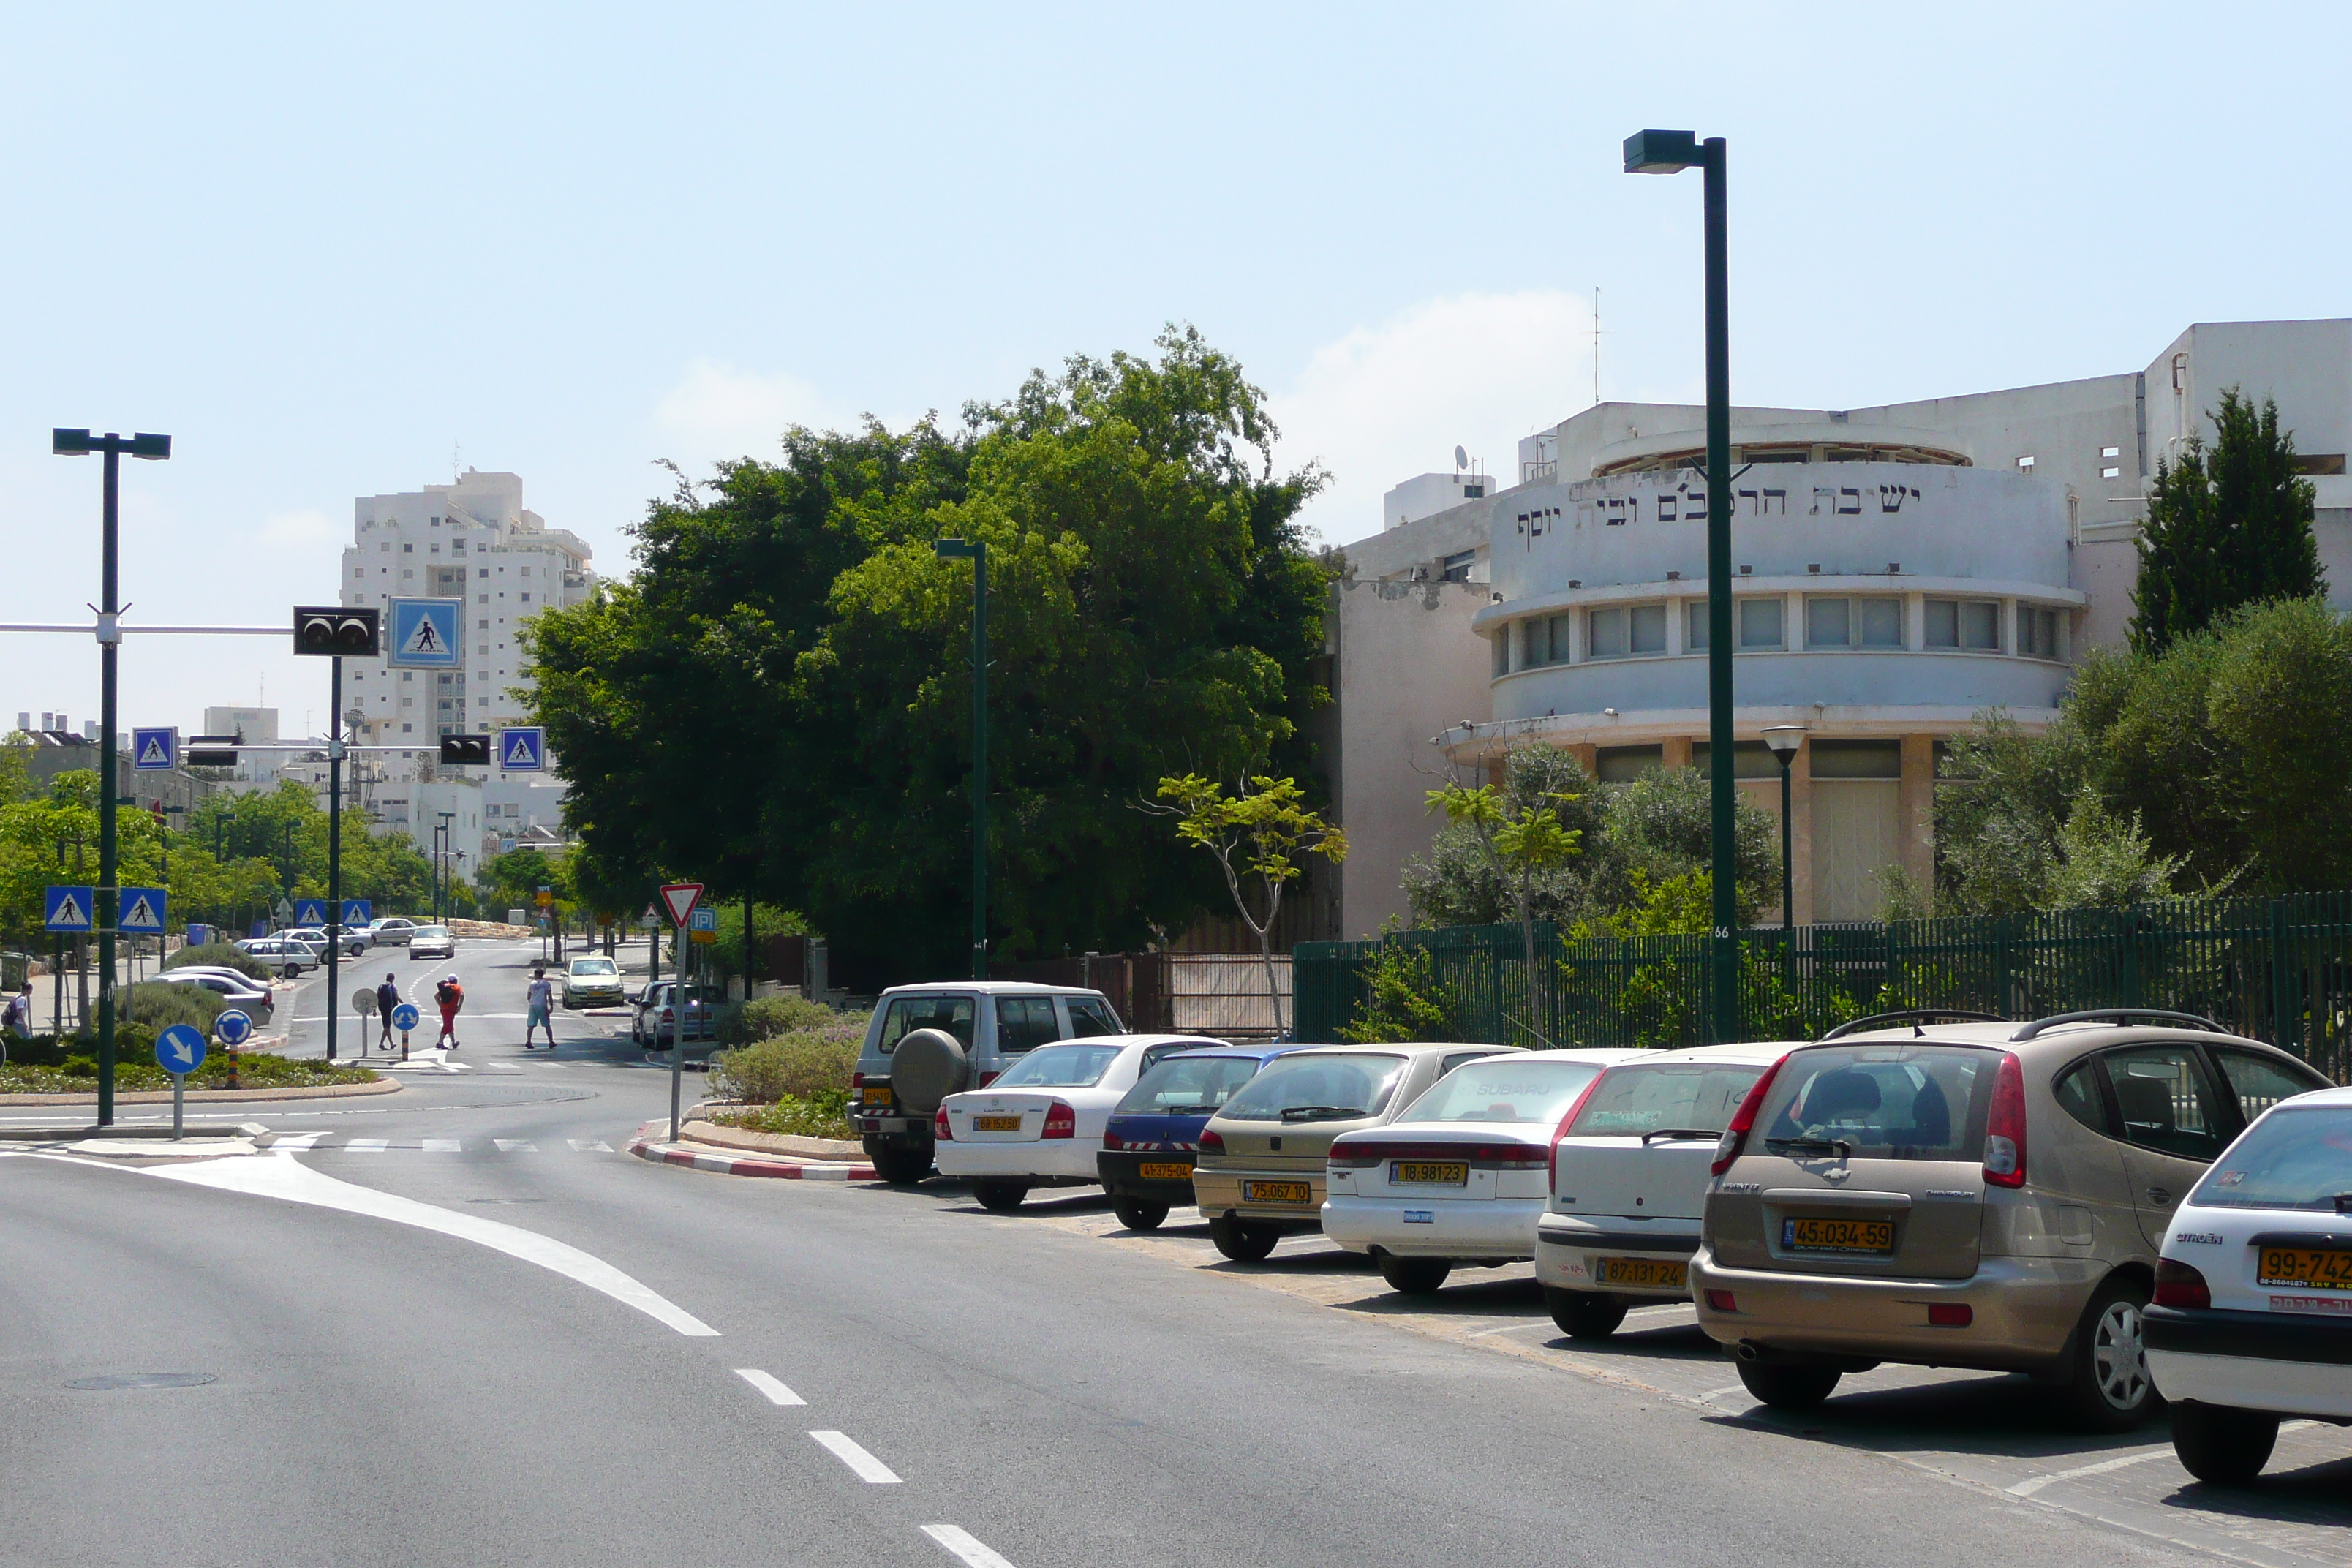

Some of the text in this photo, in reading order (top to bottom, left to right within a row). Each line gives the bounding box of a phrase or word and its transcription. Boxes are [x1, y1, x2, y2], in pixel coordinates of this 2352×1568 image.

[1517, 507, 1561, 553] יוסף
[1715, 925, 1729, 938] 66
[1477, 1083, 1550, 1096] SUBARU
[1144, 1164, 1188, 1177] 41-375-04
